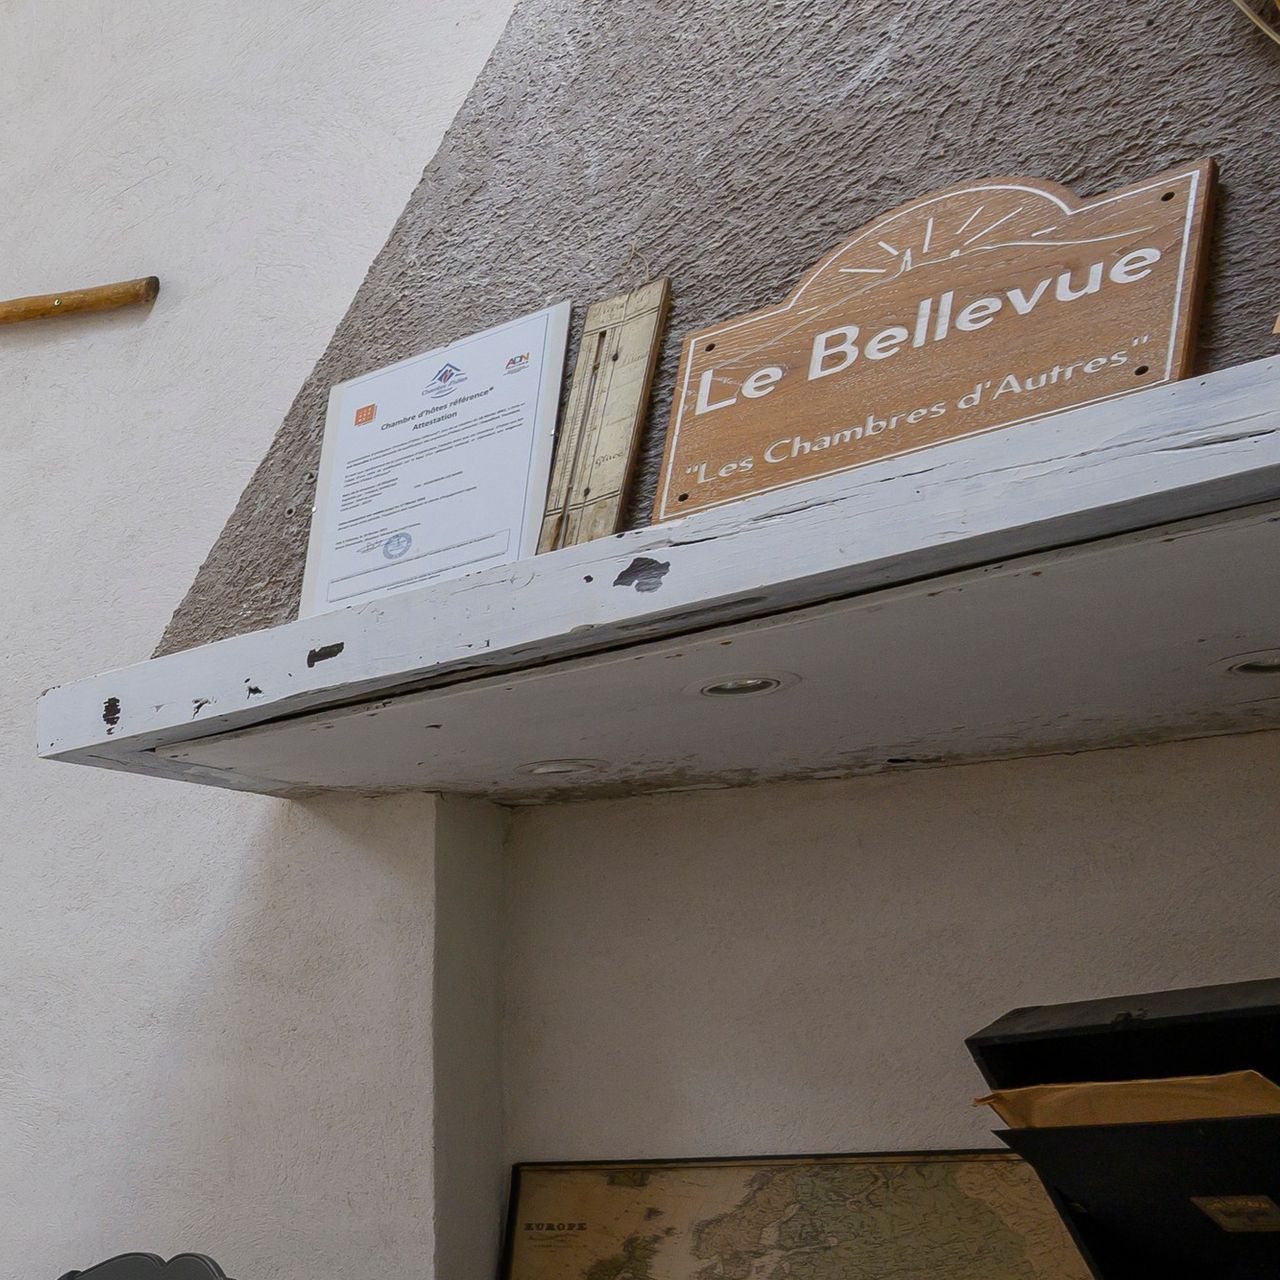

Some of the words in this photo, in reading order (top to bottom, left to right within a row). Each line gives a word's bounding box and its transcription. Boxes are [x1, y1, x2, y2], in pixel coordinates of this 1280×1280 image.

[693, 361, 784, 417] Le
[807, 245, 1162, 382] Bellevue
[381, 414, 416, 431] Chambre
[417, 403, 448, 419] d'hôtes
[412, 411, 458, 431] Attestation
[763, 396, 946, 472] Chambres
[524, 1222, 587, 1232] EUROPE
